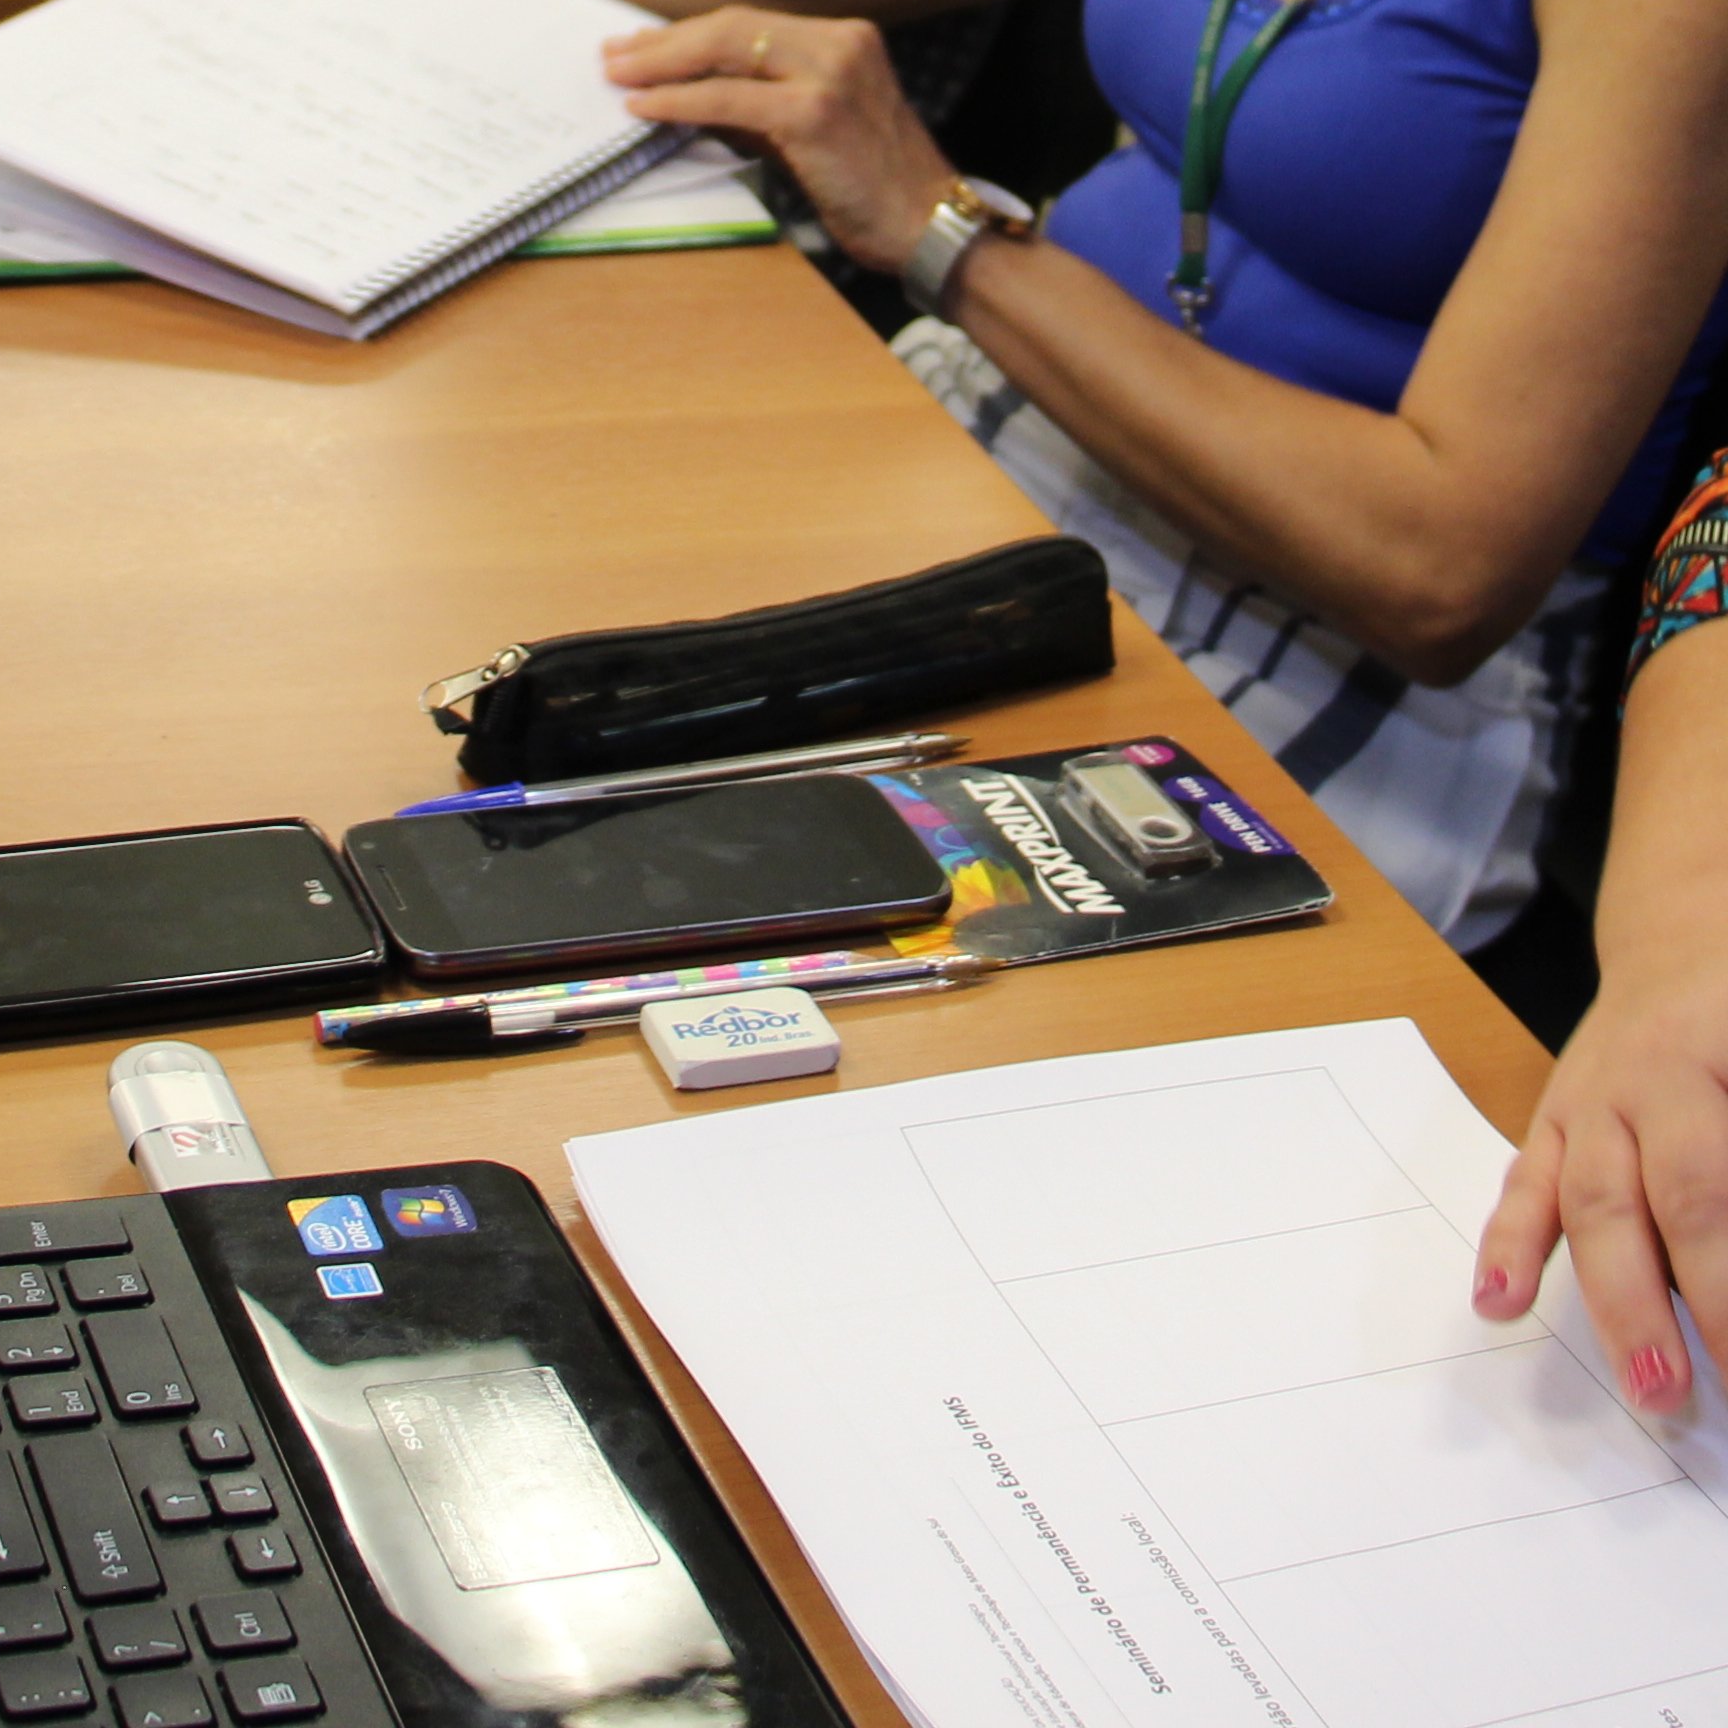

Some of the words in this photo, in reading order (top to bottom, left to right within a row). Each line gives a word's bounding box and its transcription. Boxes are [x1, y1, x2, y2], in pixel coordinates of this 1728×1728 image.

[1207, 801, 1251, 832] DRIVE
[959, 776, 1126, 915] MAXPRINT
[1238, 830, 1272, 853] PEN
[672, 1010, 802, 1040] Redbor
[725, 1032, 758, 1048] 20
[758, 1033, 783, 1044] Ind.
[784, 1030, 816, 1041] Bras.
[30, 1221, 52, 1248] Enter
[343, 1219, 372, 1249] CORE
[19, 1271, 38, 1287] Dn
[117, 1273, 139, 1293] Del
[25, 1288, 46, 1303] Pg
[7, 1347, 34, 1359] 2
[60, 1390, 85, 1414] End
[126, 1391, 152, 1404] 0
[164, 1383, 183, 1402] Ins
[27, 1405, 52, 1414] 1
[942, 1394, 980, 1430] IFMS
[383, 1395, 425, 1451] SONY
[971, 1430, 994, 1451] do
[987, 1451, 1021, 1490] Êxito
[1012, 1489, 1029, 1500] e
[1120, 1511, 1152, 1548] local:
[92, 1528, 122, 1563] Shift
[944, 1539, 965, 1564] Grosso
[1021, 1500, 1098, 1595] Permanência
[961, 1563, 978, 1583] Mato
[1148, 1545, 1199, 1608] comissão
[1090, 1595, 1113, 1617] de
[1193, 1606, 1209, 1617] a
[234, 1611, 263, 1638] Ctrl
[1201, 1617, 1232, 1650] para
[1106, 1618, 1173, 1695] Seminário
[1224, 1648, 1272, 1700] levadas
